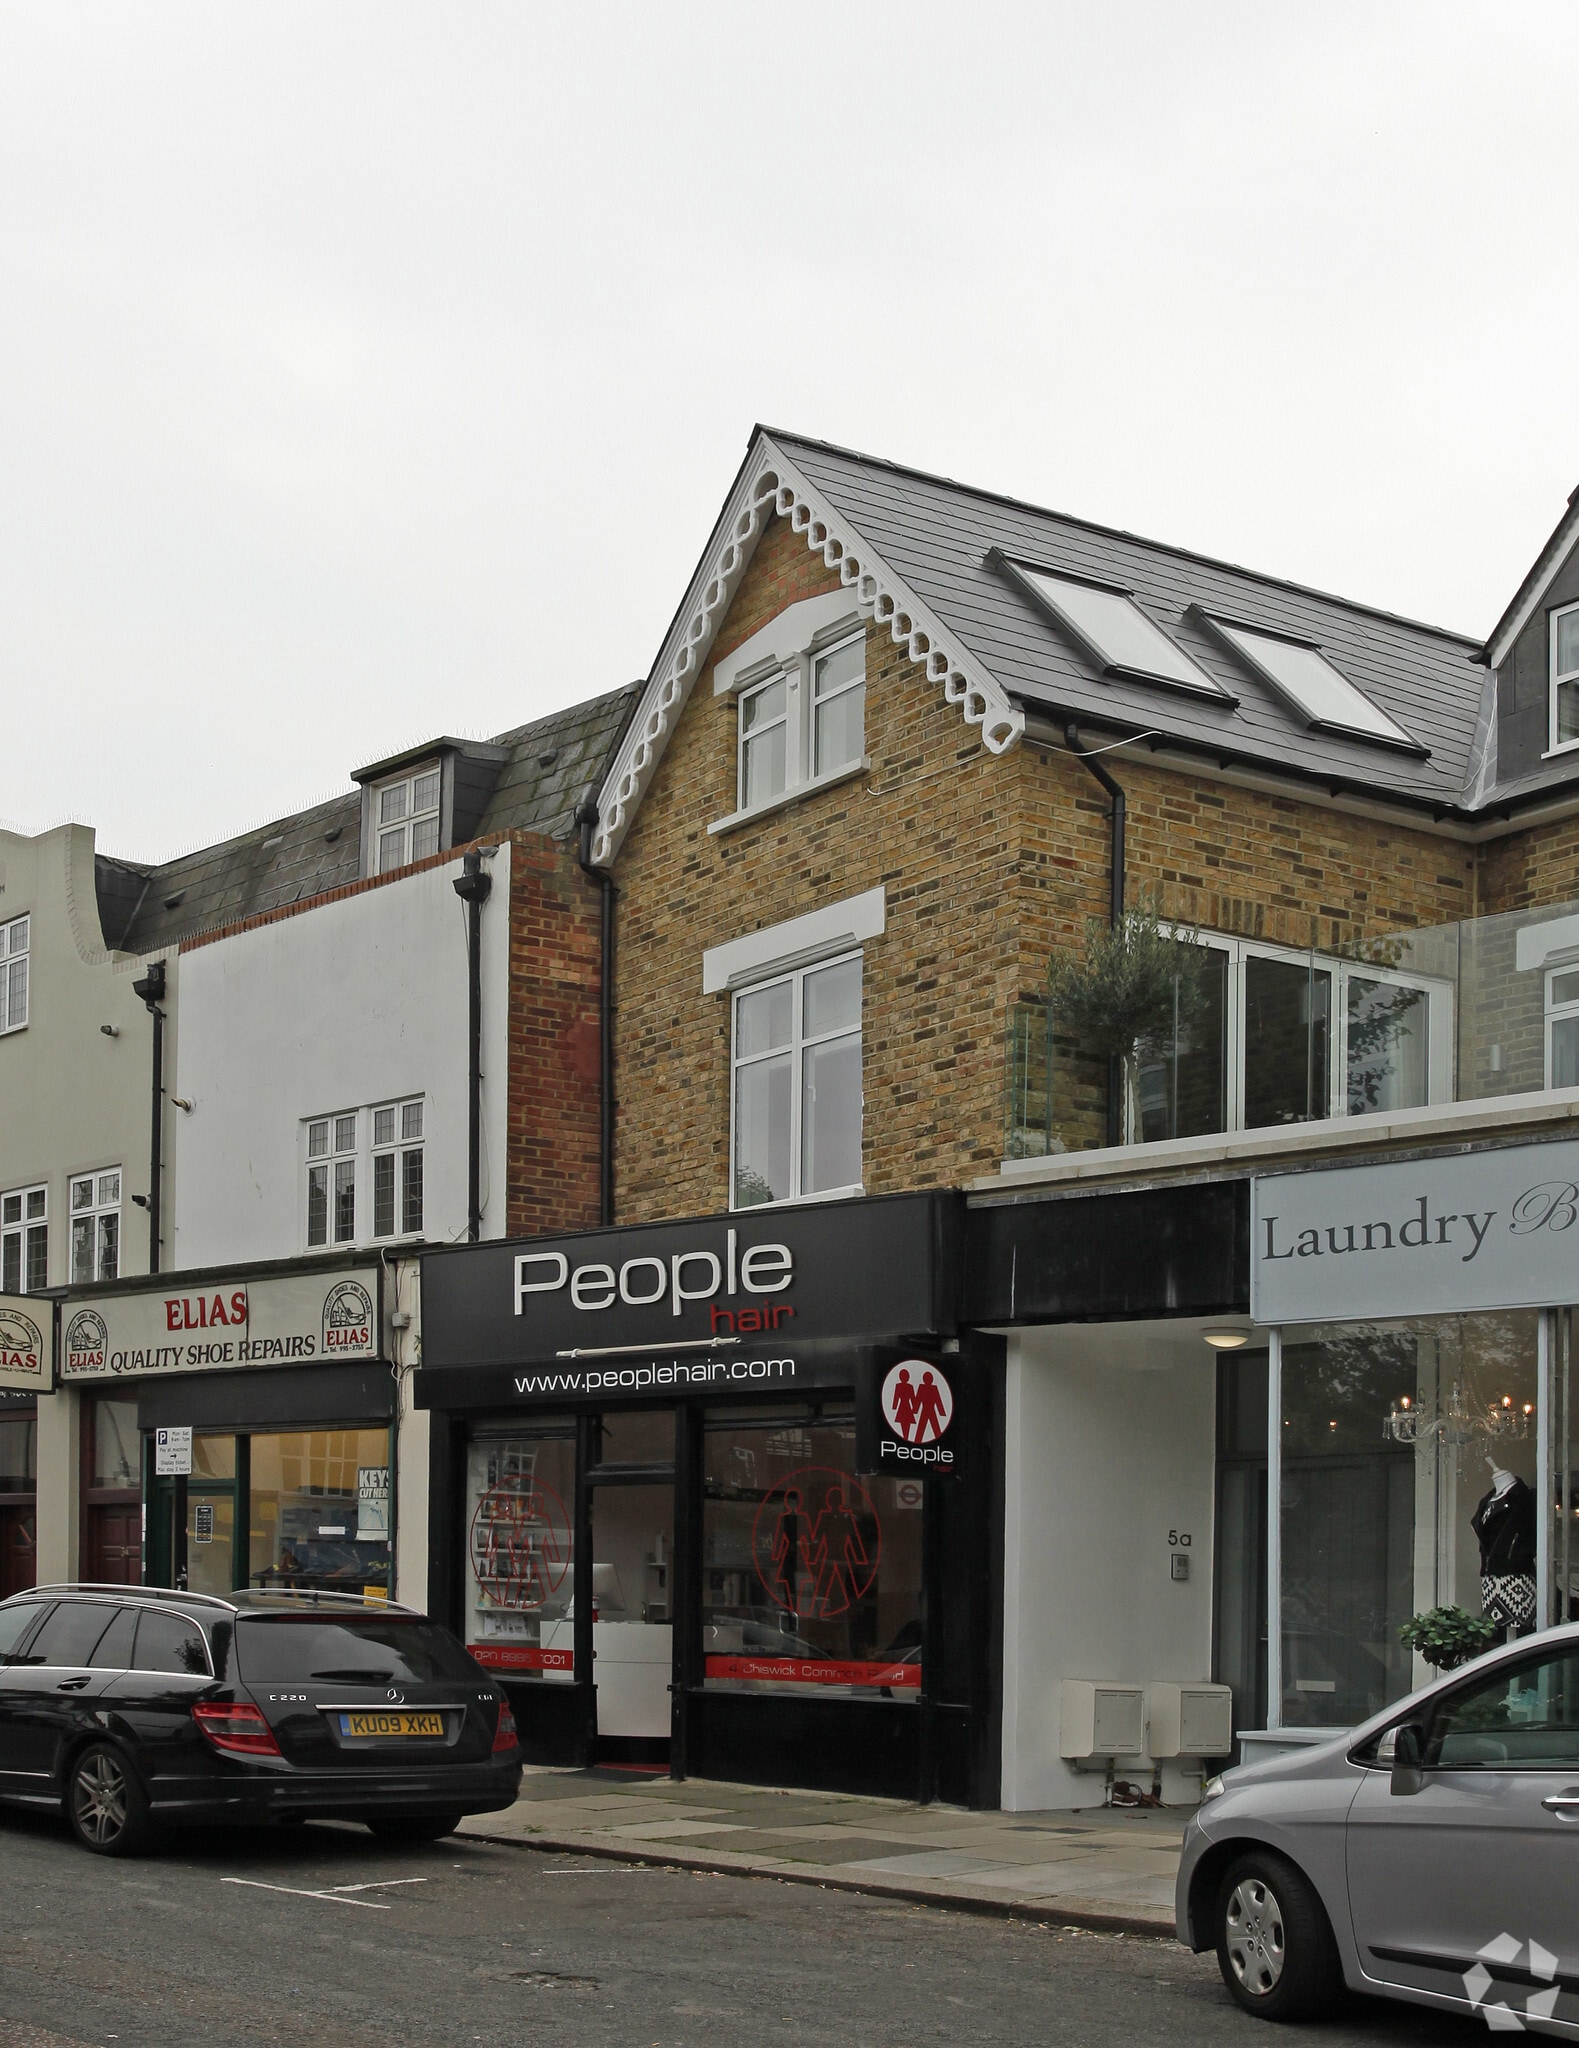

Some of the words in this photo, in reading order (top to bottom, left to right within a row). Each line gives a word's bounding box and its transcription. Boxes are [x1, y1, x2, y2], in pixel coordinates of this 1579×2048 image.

[1261, 1196, 1497, 1262] Laundry
[514, 1229, 793, 1316] People
[9, 1314, 22, 1322] AND
[164, 1292, 247, 1331] ELIAS
[711, 1301, 795, 1333] hair
[326, 1327, 369, 1346] ELIAS
[0, 1350, 37, 1368] IAS
[69, 1351, 104, 1367] ELIAS
[110, 1346, 184, 1373] QUALITY
[186, 1342, 234, 1366] SHOE
[238, 1335, 316, 1361] REPAIRS
[514, 1358, 796, 1393] www.peoplehair.com
[881, 1441, 954, 1464] People
[359, 1487, 373, 1499] CUT
[1168, 1530, 1192, 1546] 5a
[729, 1663, 738, 1673] 4
[742, 1662, 796, 1676] Chiswick
[802, 1665, 863, 1678] Common
[353, 1714, 401, 1733] KU09
[407, 1713, 441, 1732] XKH
